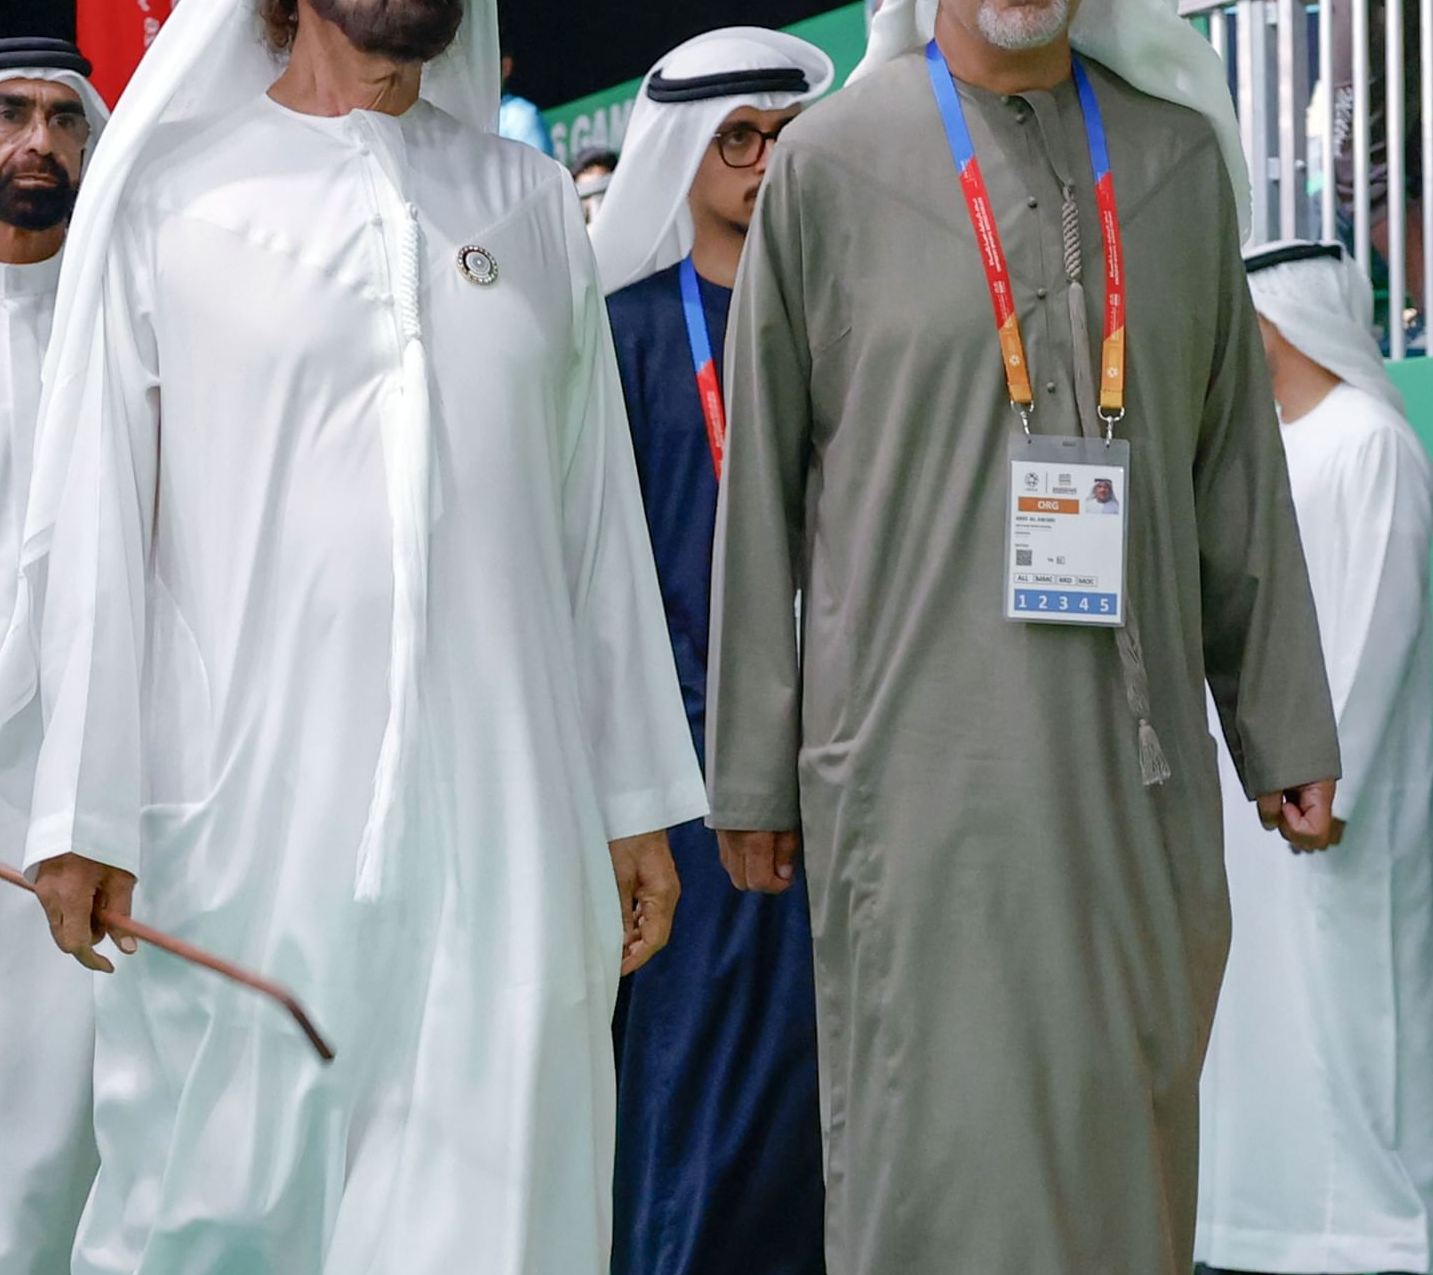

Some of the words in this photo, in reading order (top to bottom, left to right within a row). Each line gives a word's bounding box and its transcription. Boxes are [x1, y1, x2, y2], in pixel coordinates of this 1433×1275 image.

[569, 101, 635, 157] GAM
[1037, 499, 1059, 511] ORG
[1019, 594, 1027, 608] 1
[1039, 595, 1048, 609] 2
[1059, 596, 1069, 611] 3
[1079, 597, 1089, 612] 4
[1100, 598, 1109, 613] 5
